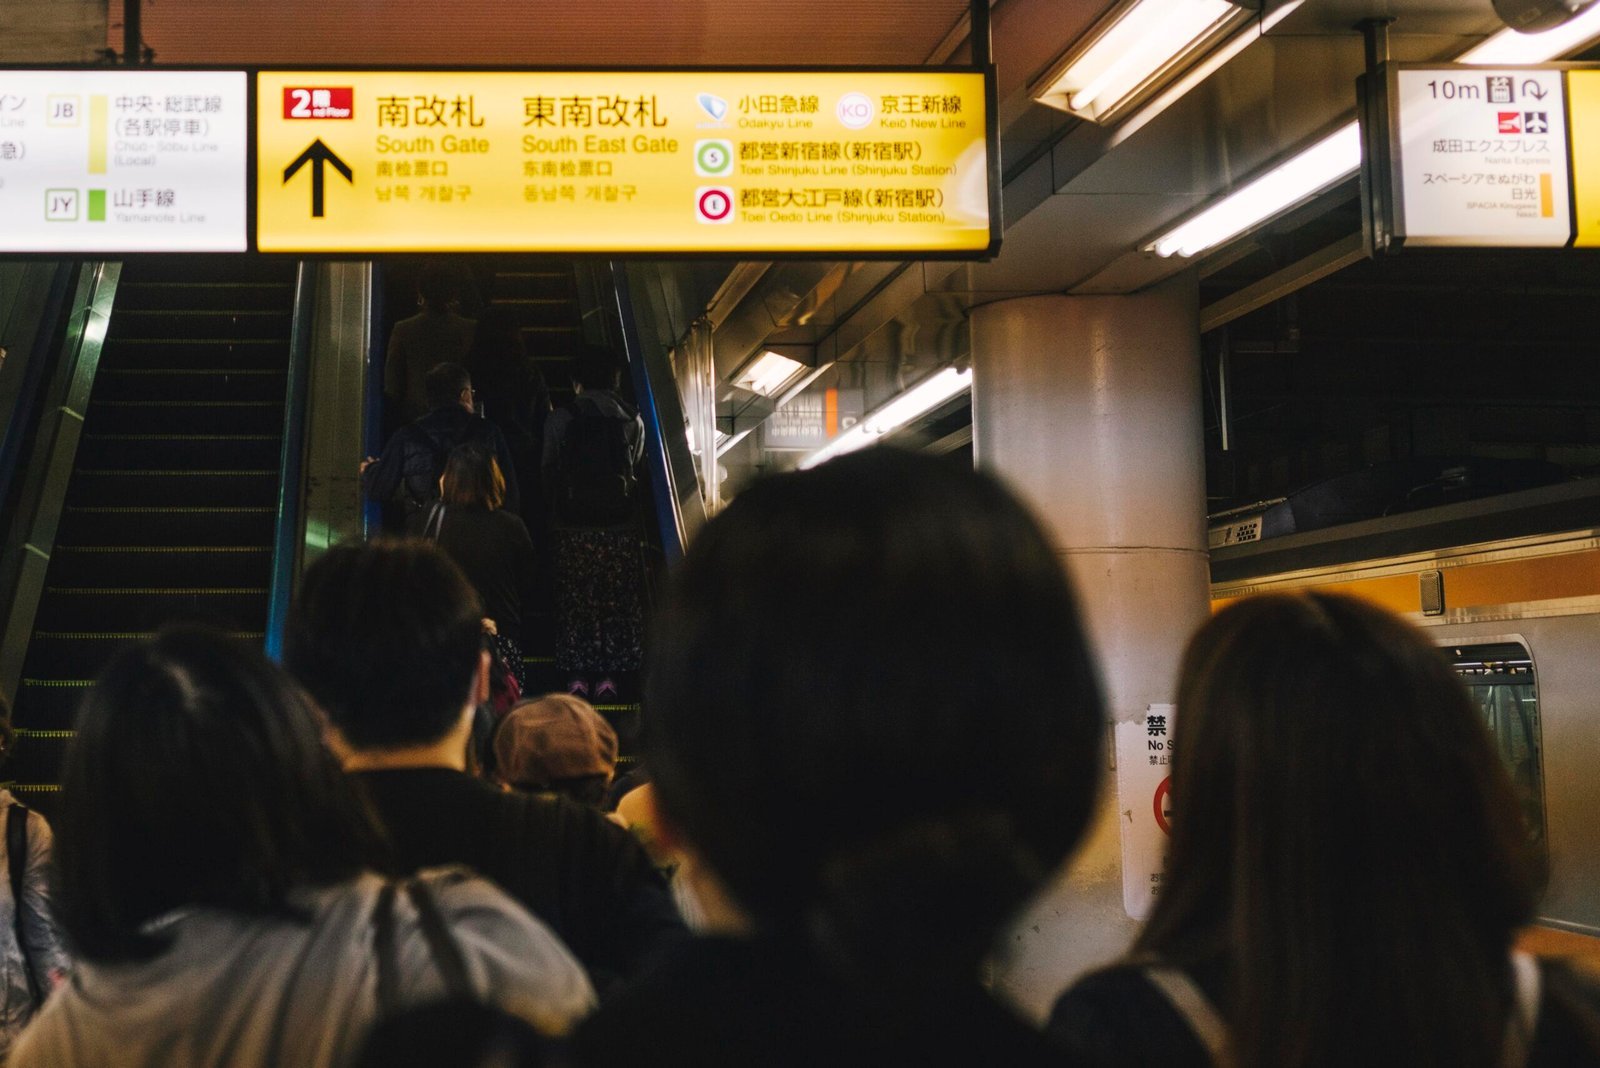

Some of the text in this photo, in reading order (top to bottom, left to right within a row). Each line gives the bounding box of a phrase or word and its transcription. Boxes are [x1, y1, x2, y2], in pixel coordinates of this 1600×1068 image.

[1428, 80, 1479, 99] 10m
[54, 103, 74, 118] JB
[376, 95, 485, 128] 南改札
[523, 95, 668, 128] 東南改札
[738, 95, 819, 114] 小田急線
[842, 103, 868, 117] KO
[880, 95, 962, 114] 京王新線
[738, 118, 784, 131] Odakyu
[788, 118, 813, 129] Line
[911, 118, 937, 129] New
[941, 118, 966, 129] Line
[376, 134, 490, 153] South Gate
[522, 134, 679, 153] South East Gate
[740, 164, 957, 178] Toei Shinjuku Line (Shinjuku Station)
[113, 189, 176, 208] 山手線
[1512, 188, 1538, 200] 日光
[52, 197, 73, 213] JY
[740, 212, 766, 223] Toei
[807, 212, 832, 223] Line
[837, 211, 894, 225] (Shinjuku
[898, 211, 945, 225] Station)
[1148, 740, 1163, 750] No
